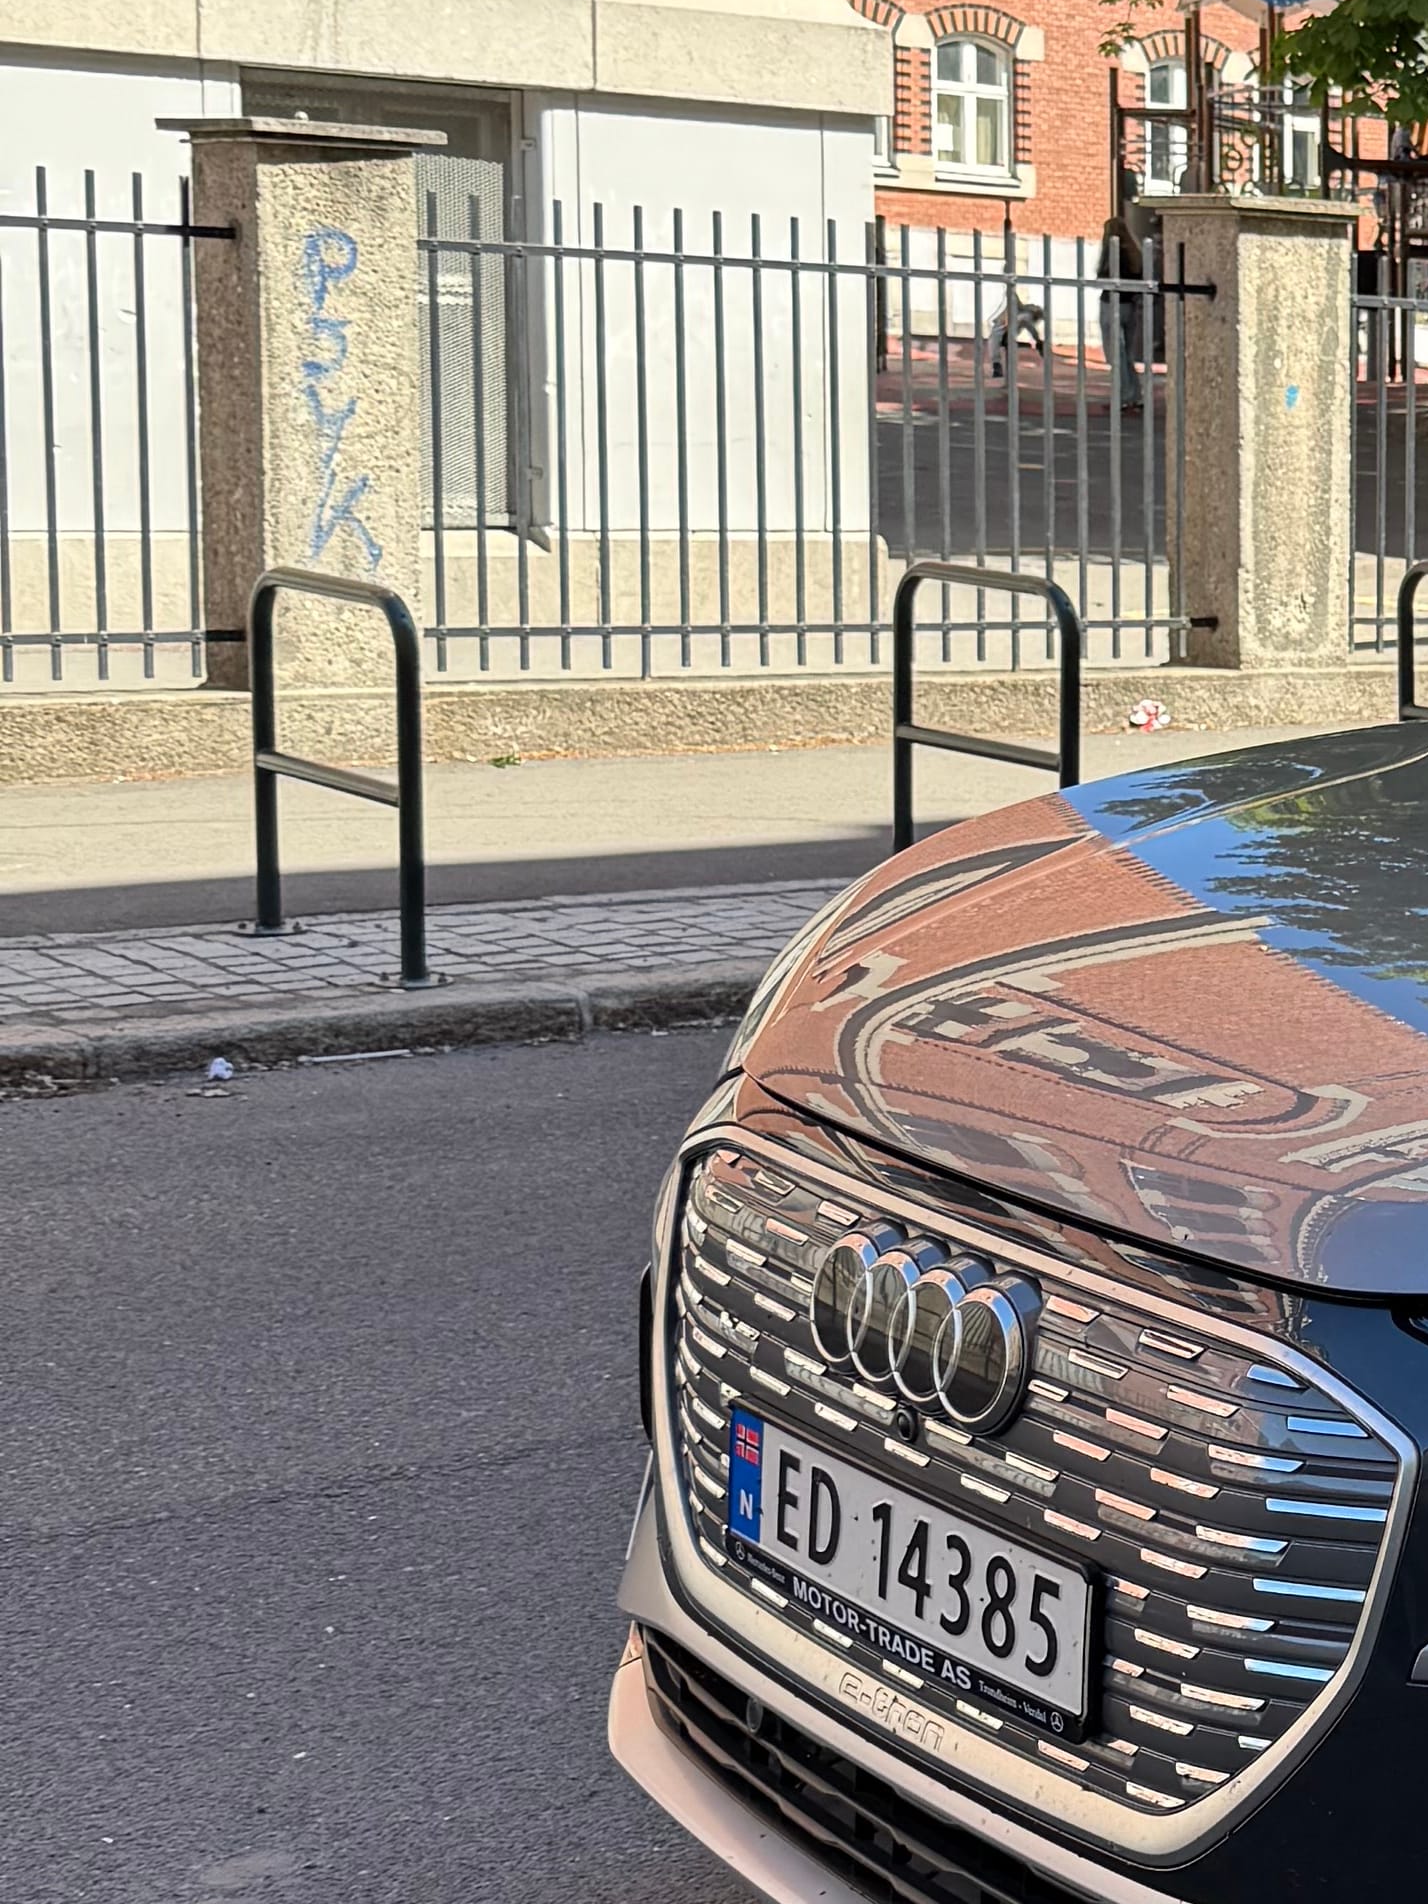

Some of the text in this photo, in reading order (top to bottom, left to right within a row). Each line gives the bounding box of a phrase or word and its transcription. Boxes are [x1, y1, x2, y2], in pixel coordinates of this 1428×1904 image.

[739, 1490, 753, 1520] N
[778, 1449, 1060, 1677] ED 14385
[793, 1576, 935, 1673] MOTOR-TRADE
[941, 1659, 971, 1690] AS
[839, 1671, 945, 1752] e-tron
